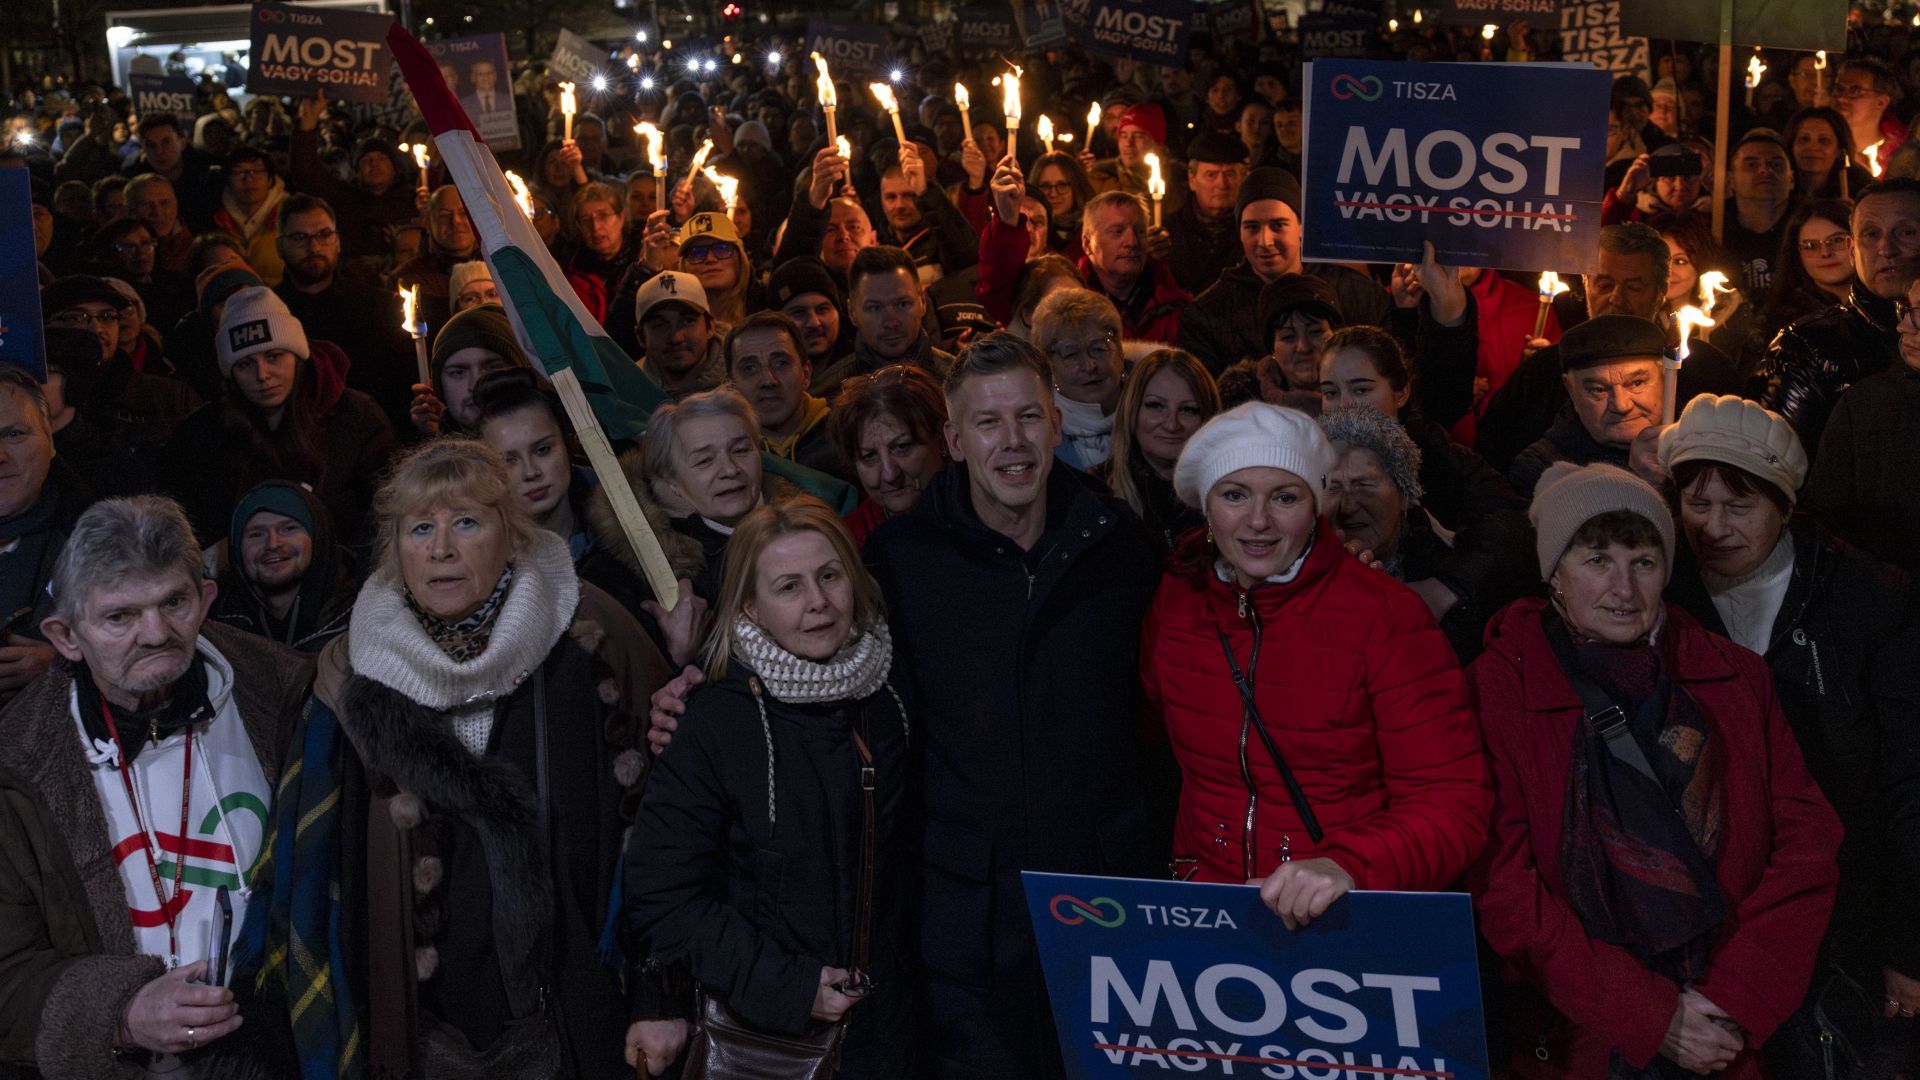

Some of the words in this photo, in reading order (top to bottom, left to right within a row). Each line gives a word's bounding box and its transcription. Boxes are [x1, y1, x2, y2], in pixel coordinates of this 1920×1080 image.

[290, 13, 324, 25] TISZA
[1094, 5, 1183, 41] MOST
[1559, 1, 1620, 29] TISZ
[961, 21, 1010, 38] MOST
[1092, 28, 1132, 45] VAGY
[1132, 36, 1178, 55] SOHA!
[1304, 30, 1366, 49] MOST
[261, 33, 381, 70] MOST
[450, 41, 480, 53] TISZA
[813, 35, 880, 61] MOST
[260, 64, 313, 81] VAGY
[317, 68, 378, 86] SOHA!
[138, 91, 193, 112] MOST
[1392, 80, 1457, 102] TISZA
[1336, 125, 1581, 196] MOST
[1334, 190, 1440, 225] VAGY
[1446, 196, 1574, 233] SOHA!
[232, 323, 266, 346] HH
[1137, 904, 1239, 930] TISZA
[1090, 955, 1441, 1049] MOST
[1091, 1031, 1242, 1076] VAGY
